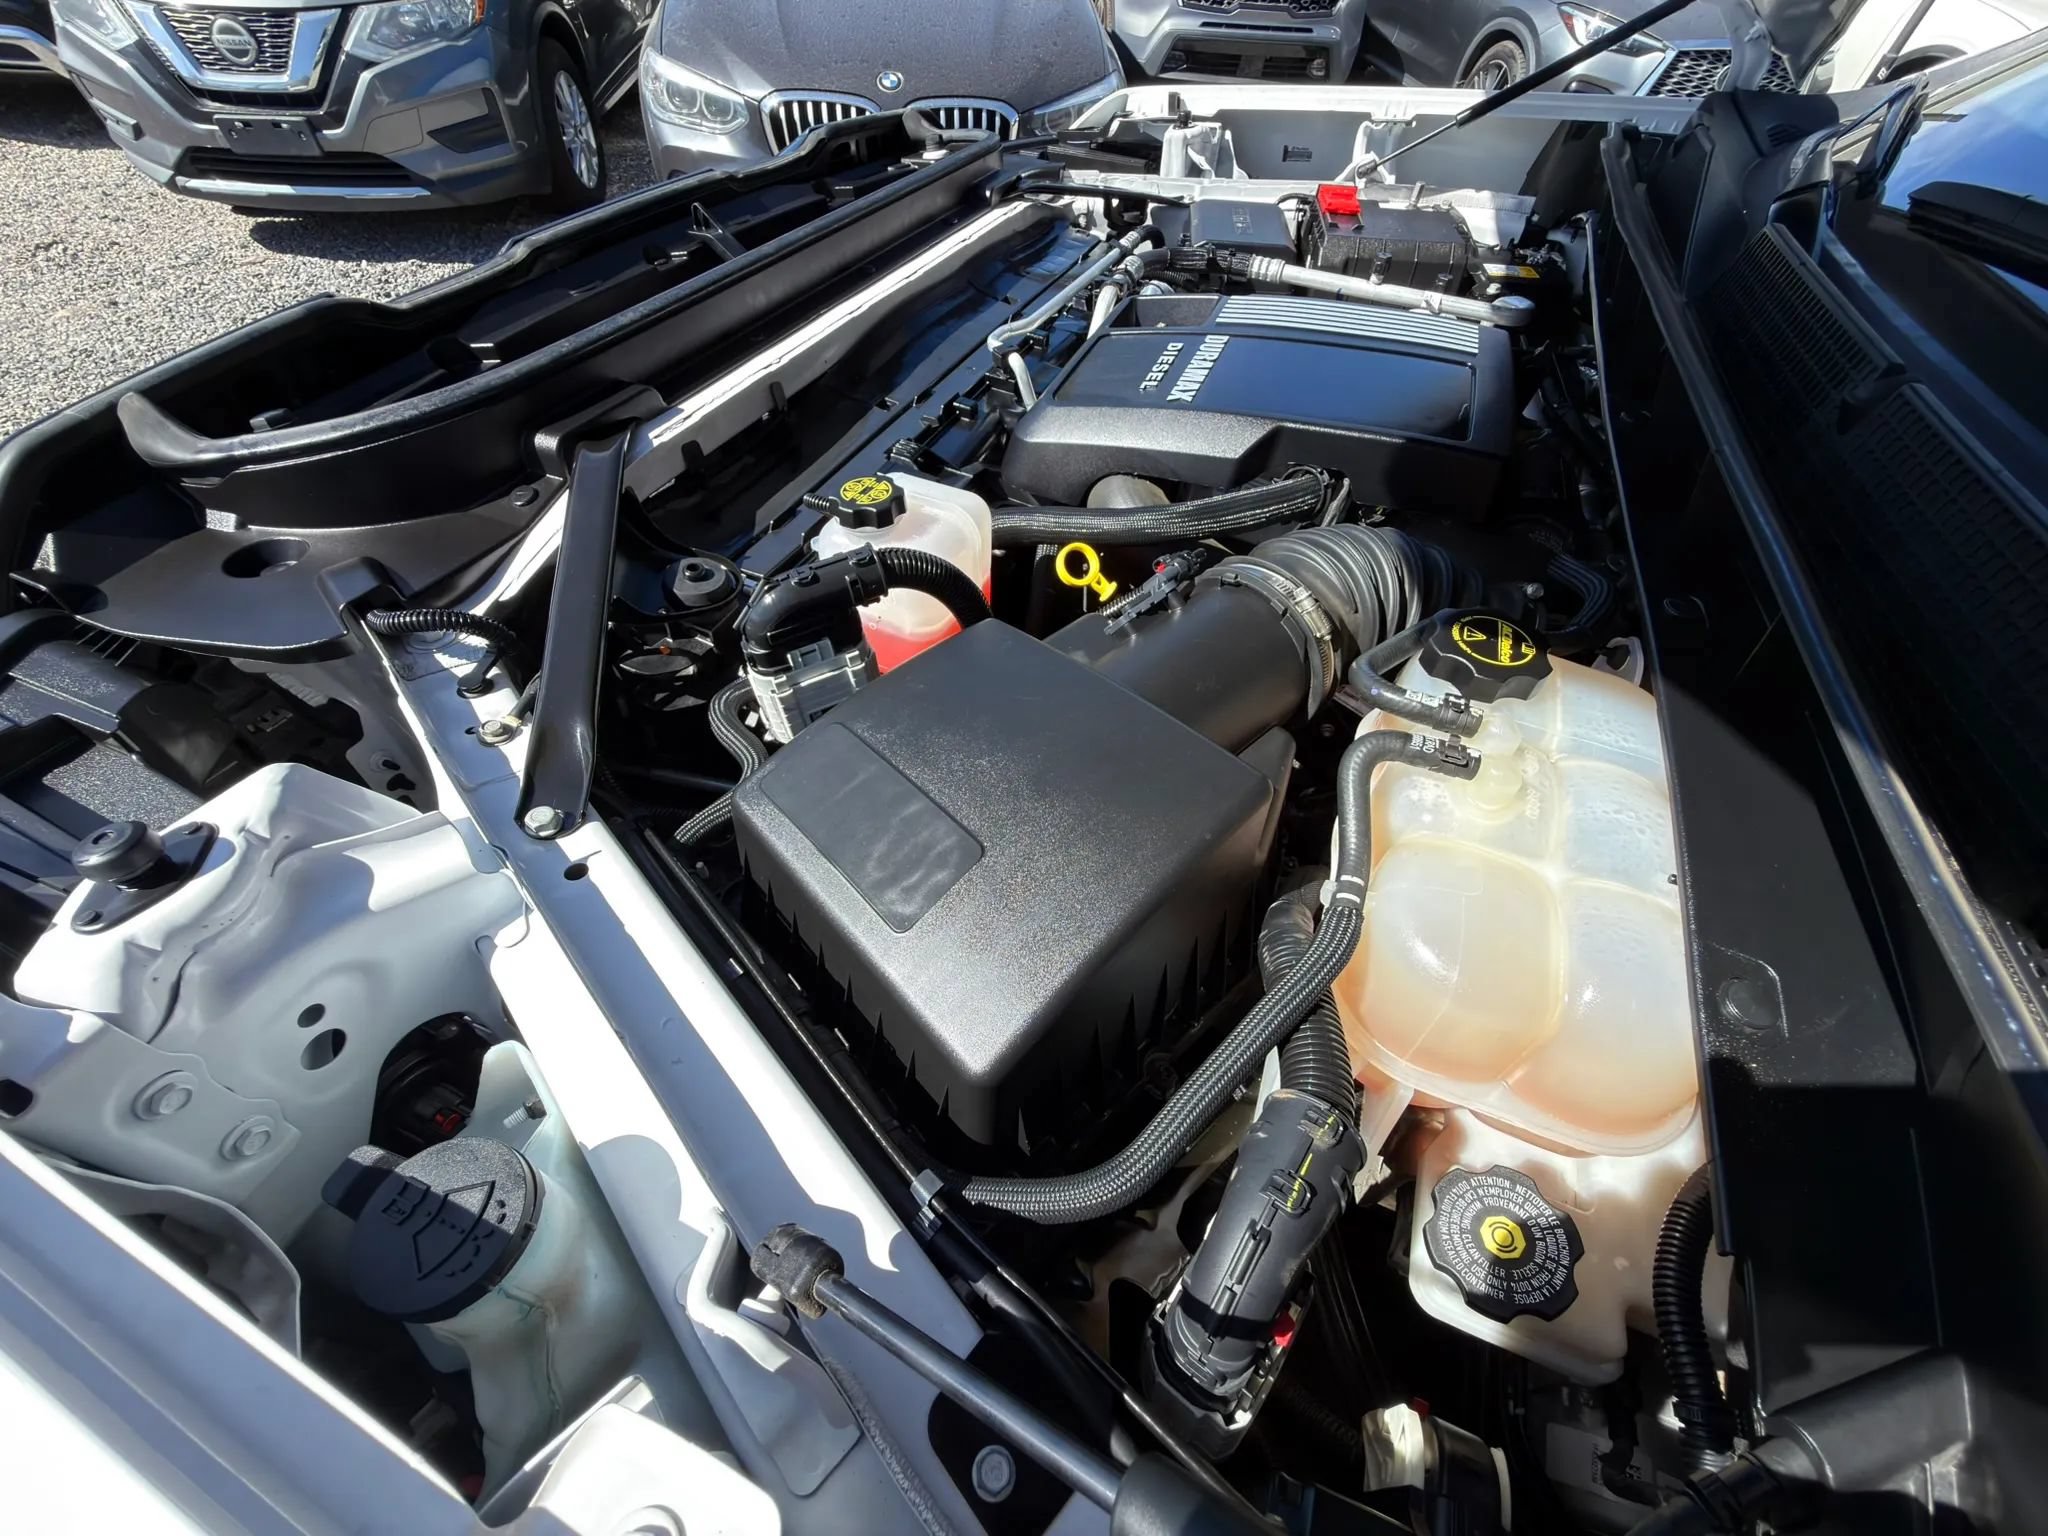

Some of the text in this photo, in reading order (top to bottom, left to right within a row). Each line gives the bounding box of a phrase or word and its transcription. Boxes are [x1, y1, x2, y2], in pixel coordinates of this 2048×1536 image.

[216, 38, 252, 47] NISSAN
[1139, 342, 1184, 391] DIESEL
[1166, 335, 1230, 403] DURAMAX
[1442, 1192, 1457, 1212] FLUID
[1464, 1190, 1477, 1203] CAP
[1477, 1187, 1524, 1205] N'EMPLOYER
[1450, 1198, 1467, 1224] BEFORE
[1524, 1202, 1540, 1217] QUE
[1438, 1211, 1449, 1233] FROM
[1537, 1217, 1549, 1228] DU
[1461, 1201, 1506, 1278] WARNING: CLEAN FILLER
[1470, 1176, 1570, 1304] ATTENTION: NETTOYER LE BOUCHON AVANT LA DEPOSE
[1483, 1197, 1546, 1280] PROVENANT D'UN BIDON SCELLE
[1544, 1230, 1558, 1260] LIQUIDE
[1444, 1240, 1464, 1270] SEALED
[1471, 1264, 1487, 1280] USE
[1545, 1260, 1556, 1272] DE
[1461, 1268, 1504, 1300] CONTAINER
[1487, 1275, 1507, 1289] ONLY
[1530, 1269, 1551, 1288] FREIN
